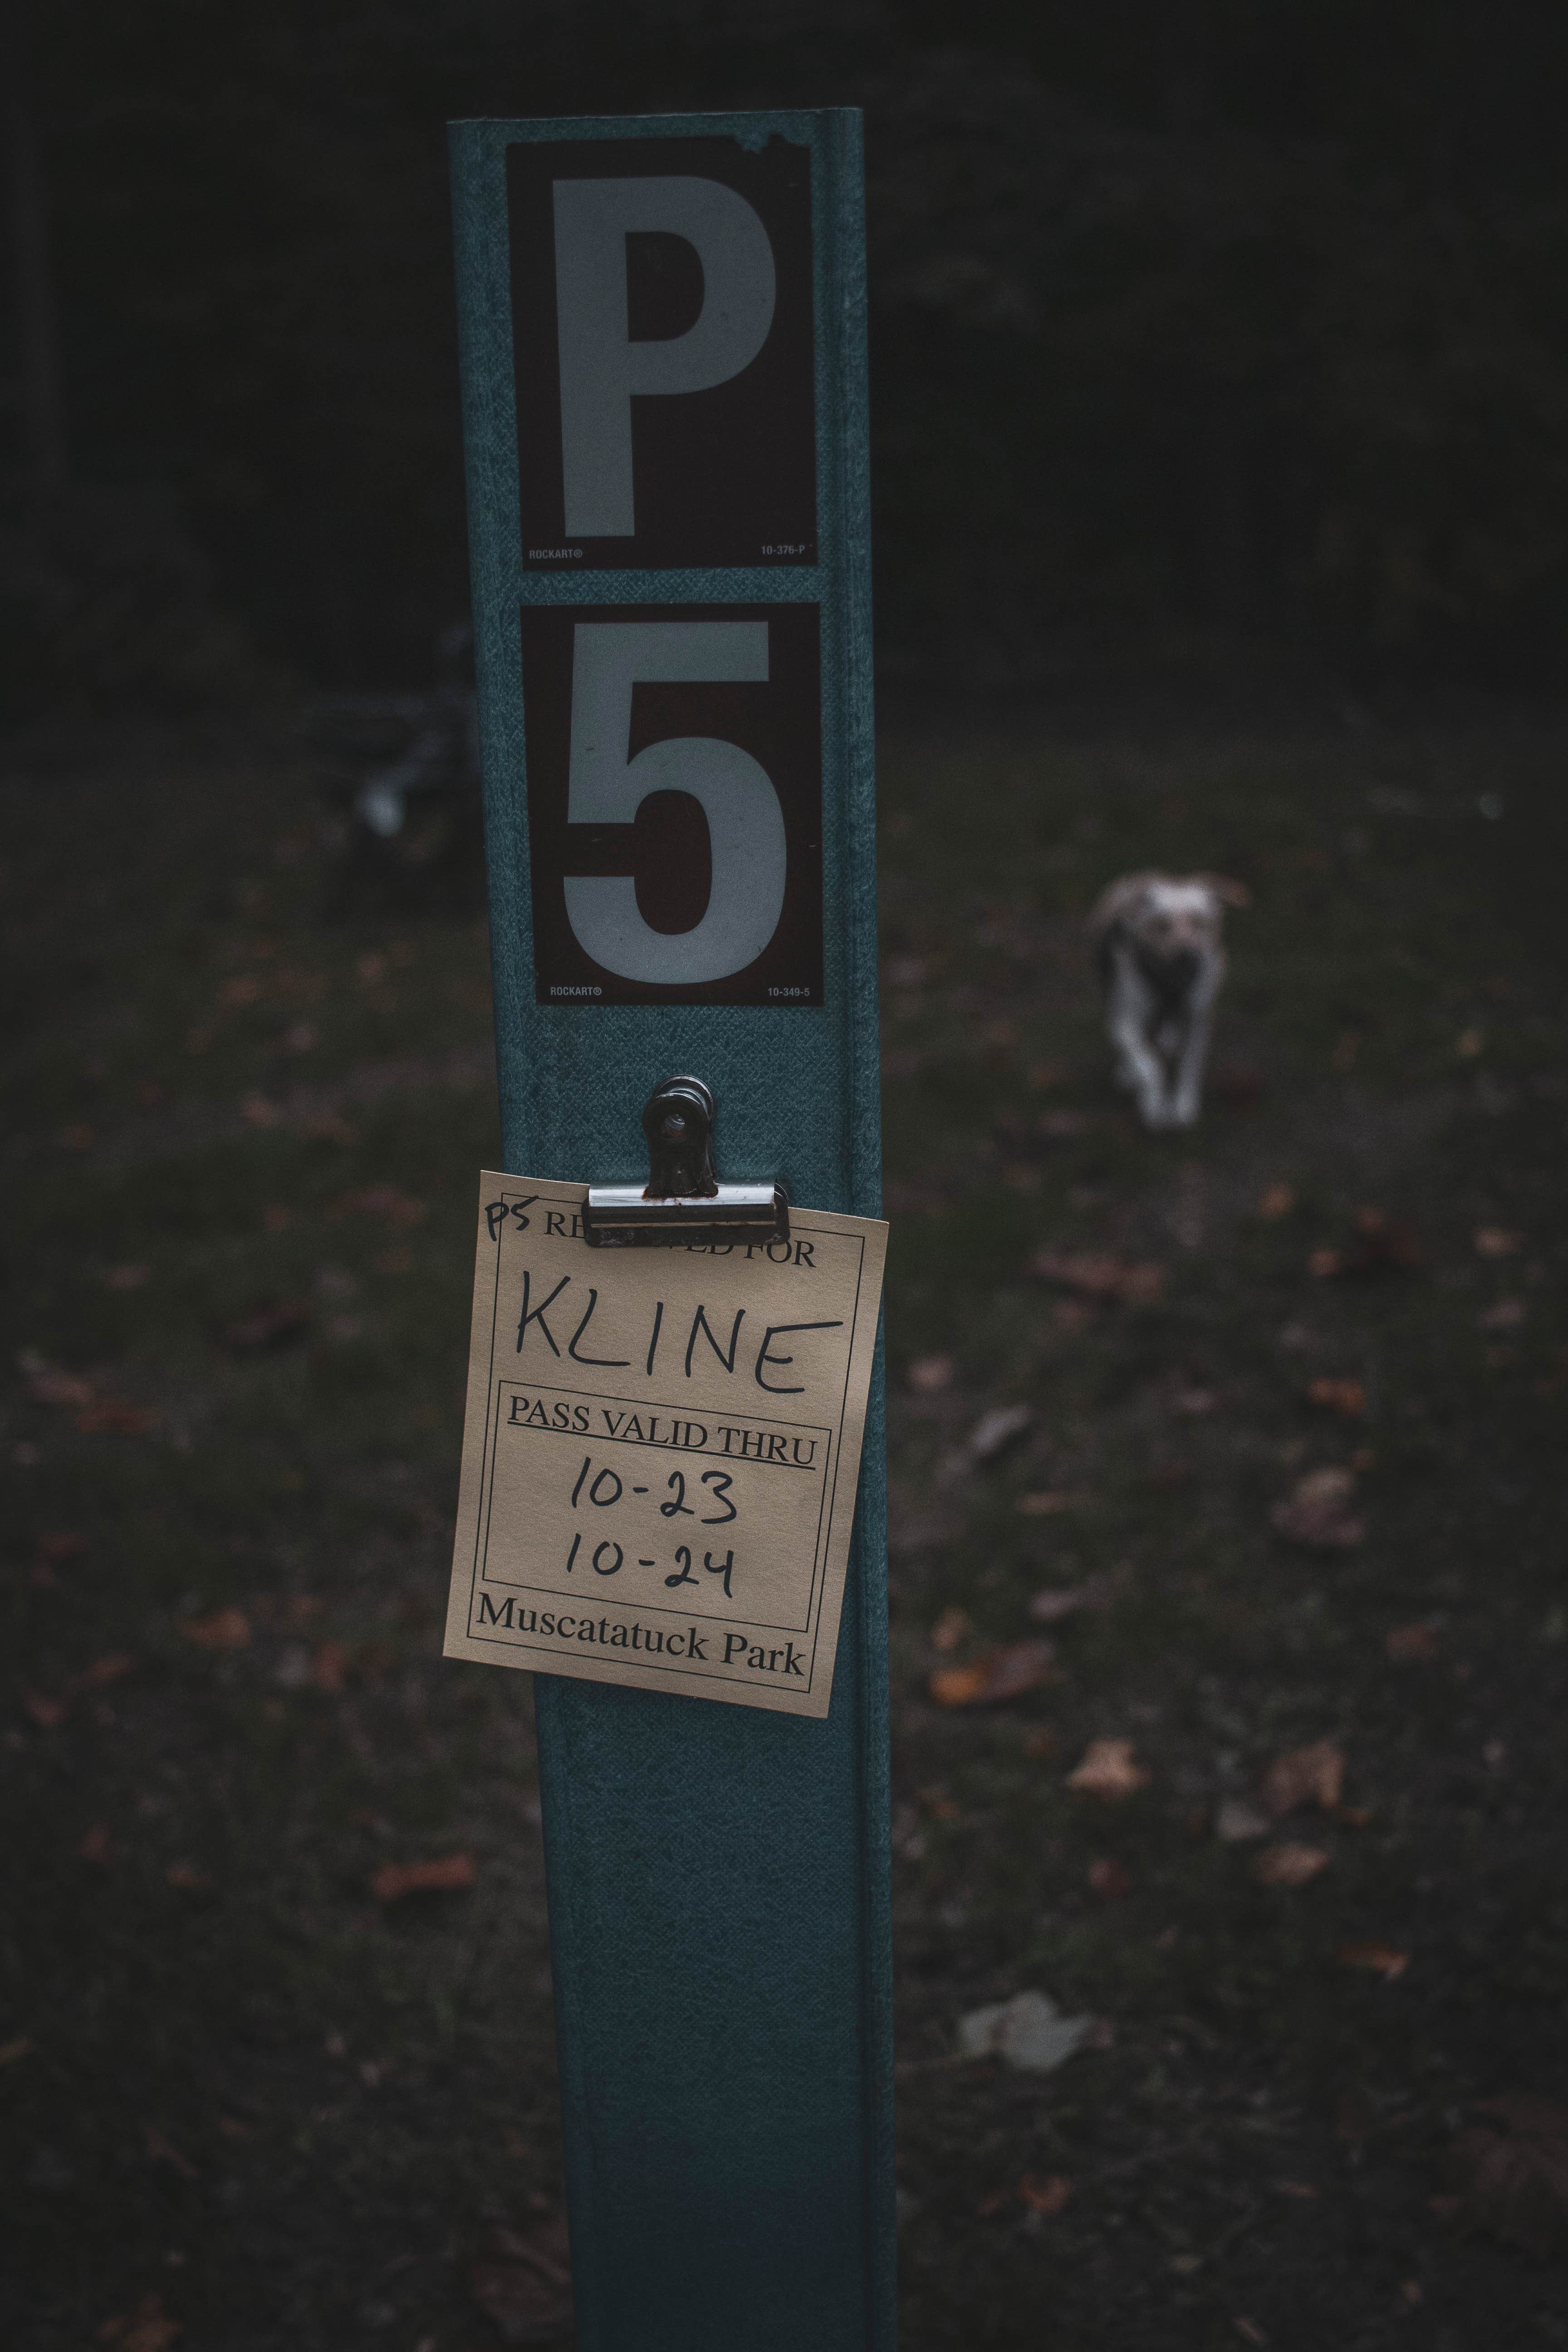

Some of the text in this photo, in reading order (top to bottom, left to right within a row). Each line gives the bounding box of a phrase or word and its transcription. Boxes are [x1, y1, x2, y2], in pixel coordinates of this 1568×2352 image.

[553, 175, 777, 538] P
[761, 545, 805, 554] 10-376-P
[563, 621, 788, 984] 5
[768, 988, 810, 996] 10-349-5
[743, 1240, 817, 1268] FOR
[516, 1270, 843, 1393] KLINE
[510, 1395, 818, 1465] PASS VALID THRU
[571, 1456, 738, 1524] 10-23
[566, 1534, 734, 1598] 10-24
[476, 1592, 806, 1676] Muscatatuck Park
